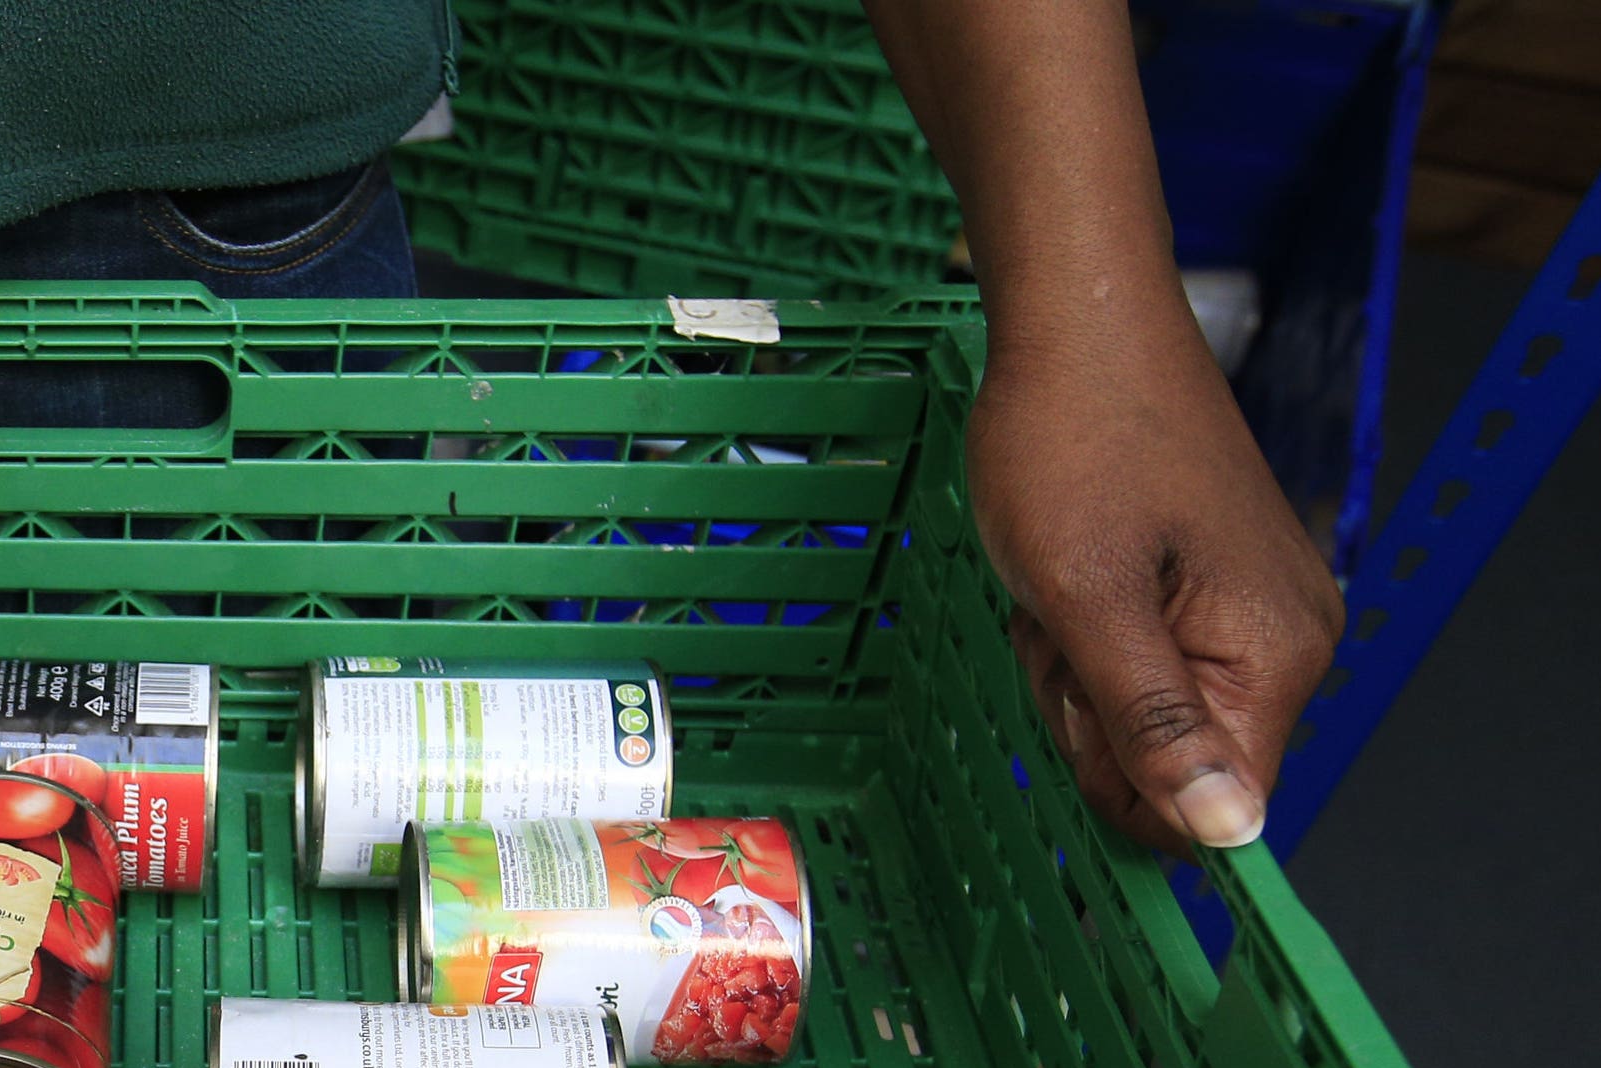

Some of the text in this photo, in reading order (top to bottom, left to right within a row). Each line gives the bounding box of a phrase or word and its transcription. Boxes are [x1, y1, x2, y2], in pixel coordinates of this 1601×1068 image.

[50, 676, 67, 701] 400g
[633, 745, 645, 754] 2
[116, 783, 139, 845] Plum
[176, 817, 190, 844] Juice
[142, 798, 167, 887] Tomatoes
[15, 914, 25, 924] in
[375, 1036, 383, 1048] out
[584, 1029, 595, 1051] counts
[452, 1046, 460, 1059] you
[588, 1053, 595, 1062] as
